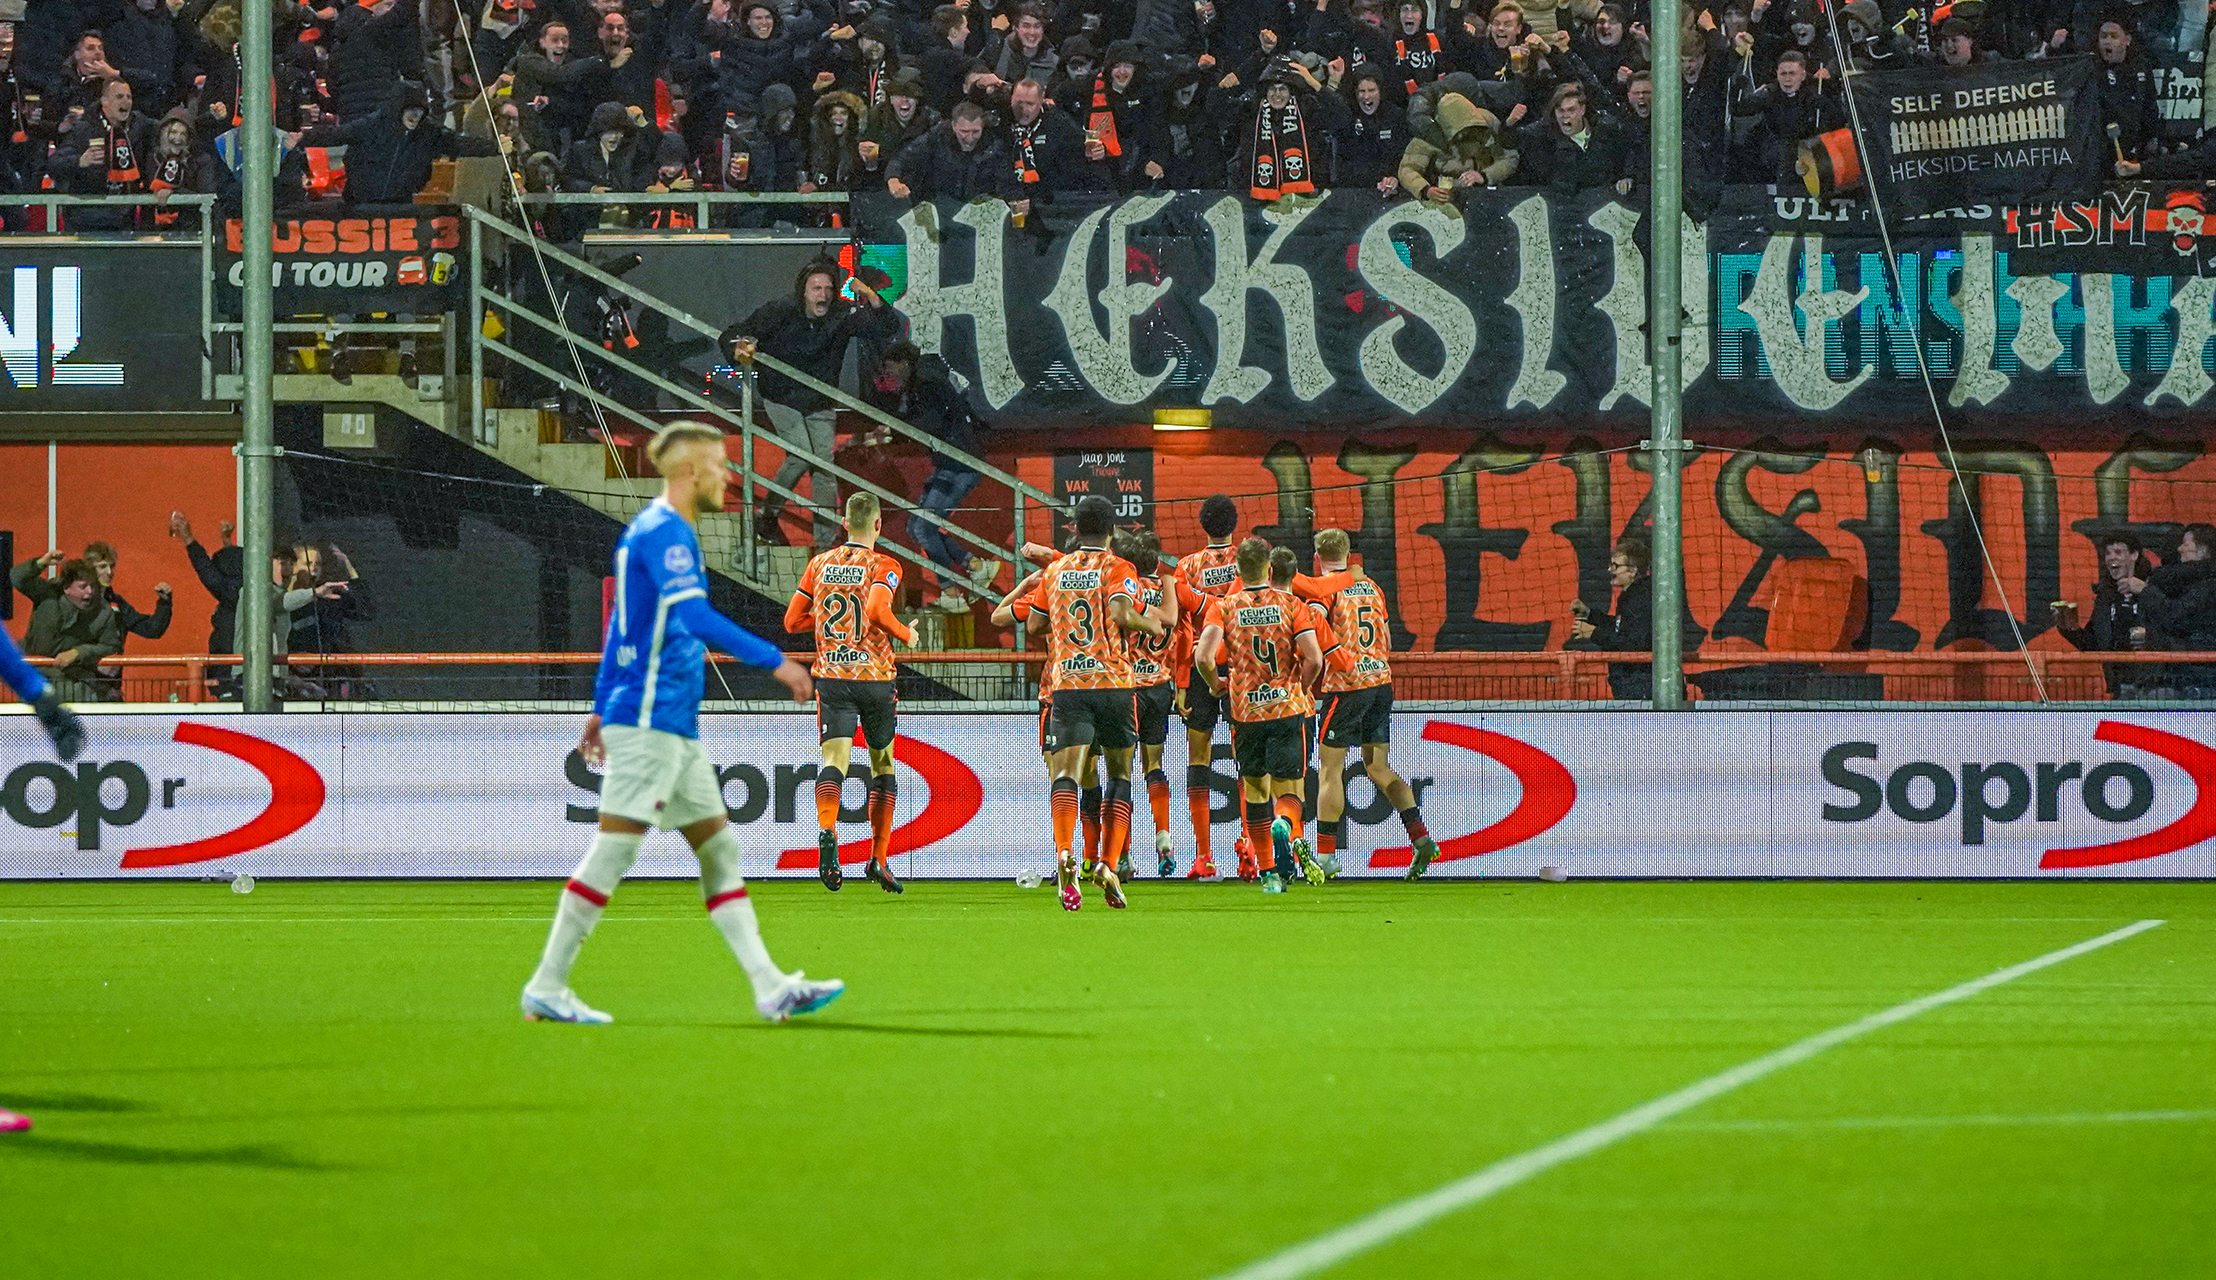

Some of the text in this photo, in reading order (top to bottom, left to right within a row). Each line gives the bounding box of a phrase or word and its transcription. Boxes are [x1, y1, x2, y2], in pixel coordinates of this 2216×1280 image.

[1890, 80, 2057, 114] SELF DEFENCE
[1890, 147, 2073, 183] HEKSIDE-MAFFIA
[431, 217, 460, 249] 3
[2017, 187, 2150, 248] HSM
[291, 260, 388, 288] TOUR
[893, 190, 1873, 414] HEKSIDE
[1065, 480, 1089, 492] VAK
[1117, 479, 1142, 492] VAK
[1115, 494, 1144, 517] JB
[825, 565, 864, 577] KEUKEN
[822, 591, 862, 641] 21
[1067, 598, 1095, 647] 3
[1239, 607, 1280, 618] KEUKEN
[1357, 605, 1375, 650] 5
[1252, 634, 1279, 678] 4
[1820, 741, 2155, 845] Sopro
